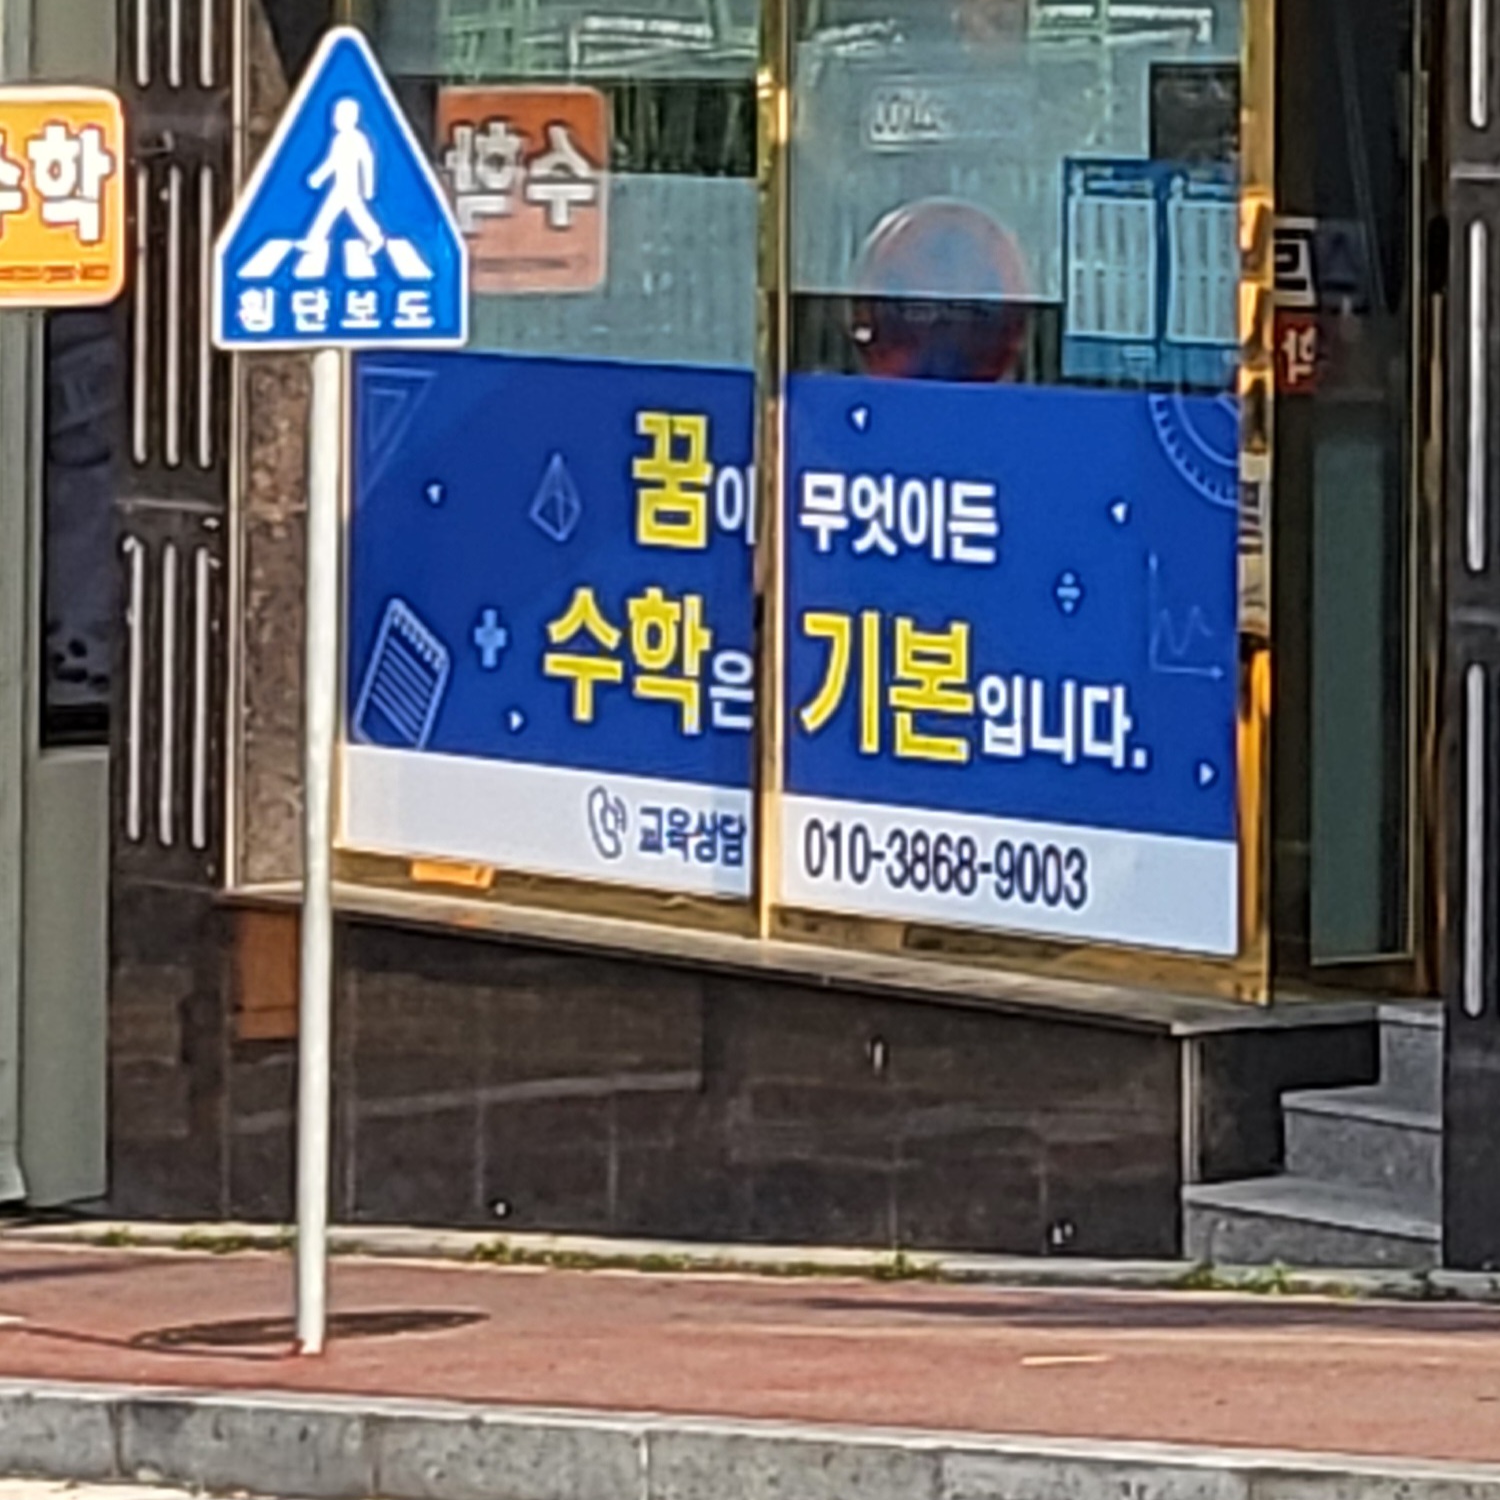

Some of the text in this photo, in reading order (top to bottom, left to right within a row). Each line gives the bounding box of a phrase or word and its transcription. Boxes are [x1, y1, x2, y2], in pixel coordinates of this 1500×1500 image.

[238, 288, 434, 332] 횡단보도
[633, 411, 998, 564] 꿈이 무엇이든
[544, 586, 1148, 768] 수학은 기본입니다.
[639, 805, 748, 867] 교육상담
[805, 819, 1088, 909] 010-3868-9003
